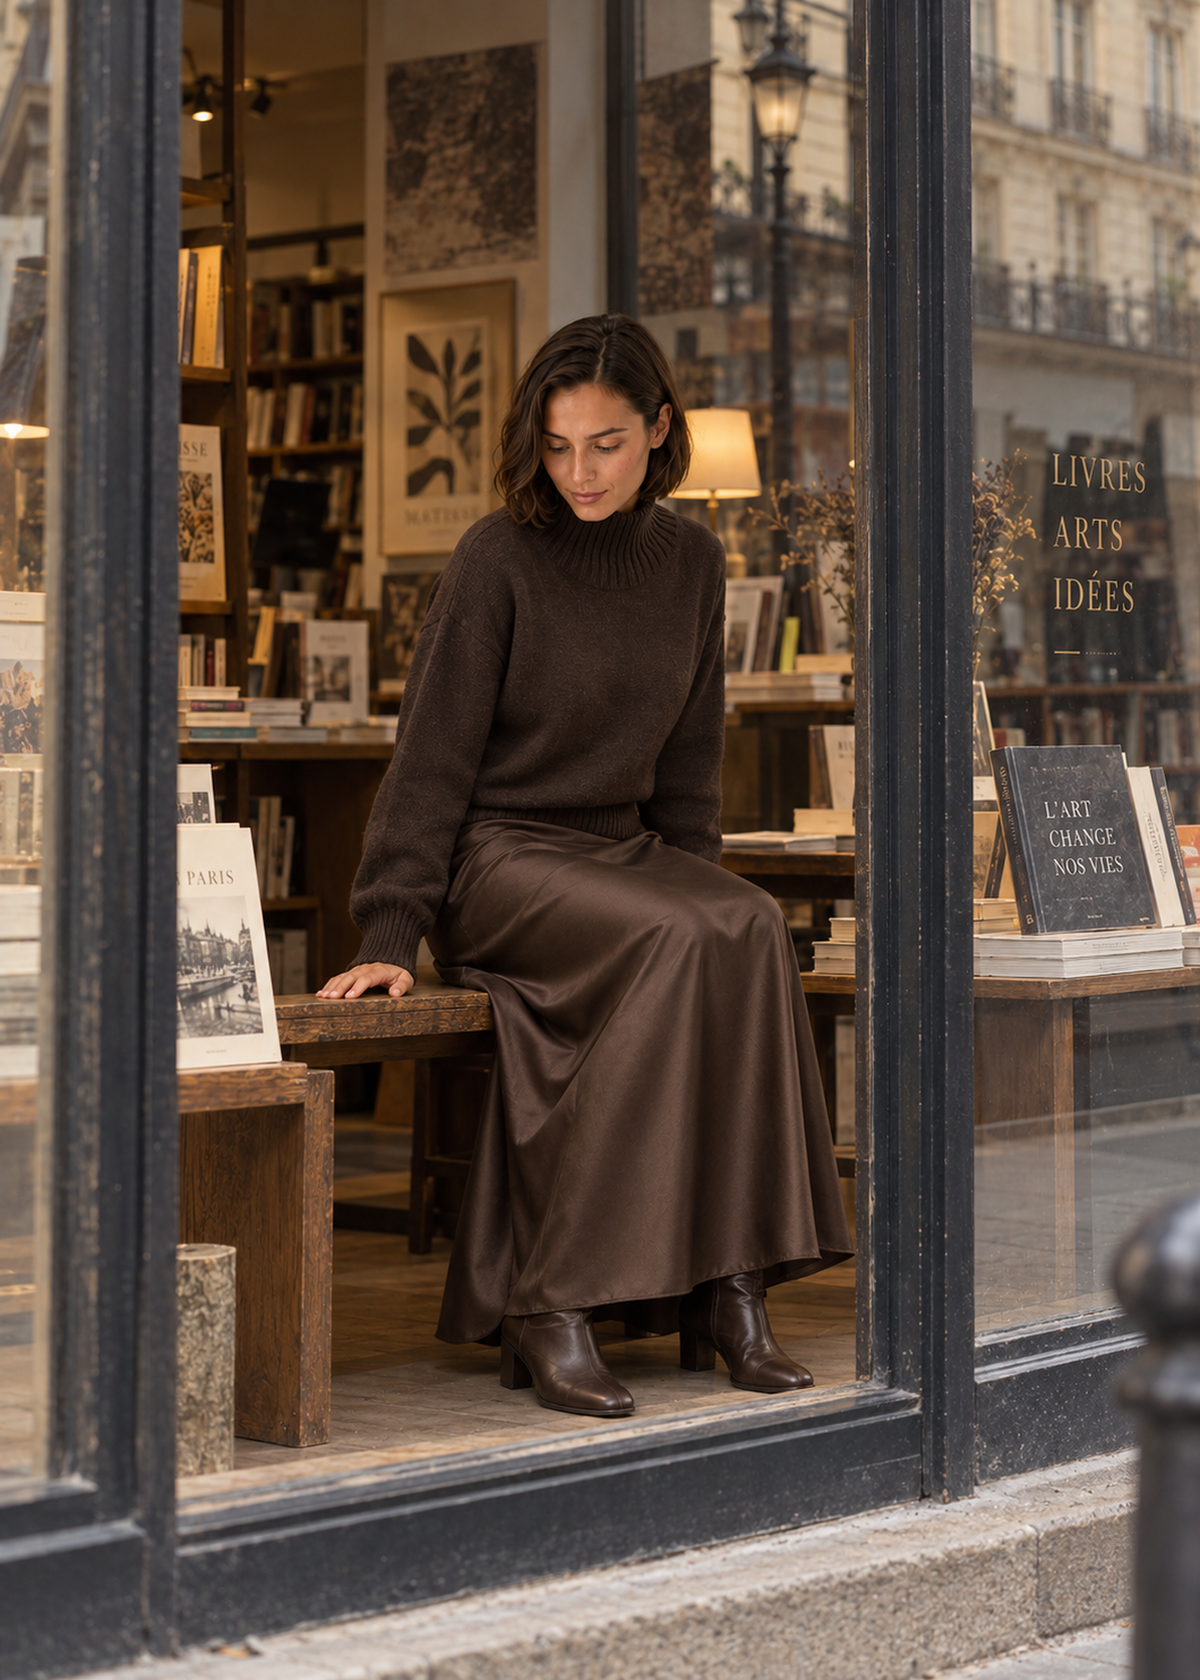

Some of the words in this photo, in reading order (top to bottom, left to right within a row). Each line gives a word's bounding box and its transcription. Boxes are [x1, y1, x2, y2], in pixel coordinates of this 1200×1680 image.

[1052, 453, 1147, 494] LIVRES
[1053, 515, 1123, 551] ARTS
[1053, 570, 1135, 613] IDÉES
[1044, 799, 1092, 819] L'ART
[1049, 827, 1117, 848] CHANGE
[1053, 857, 1087, 876] NOS
[1088, 855, 1124, 874] VIES
[186, 869, 235, 886] PARIS
